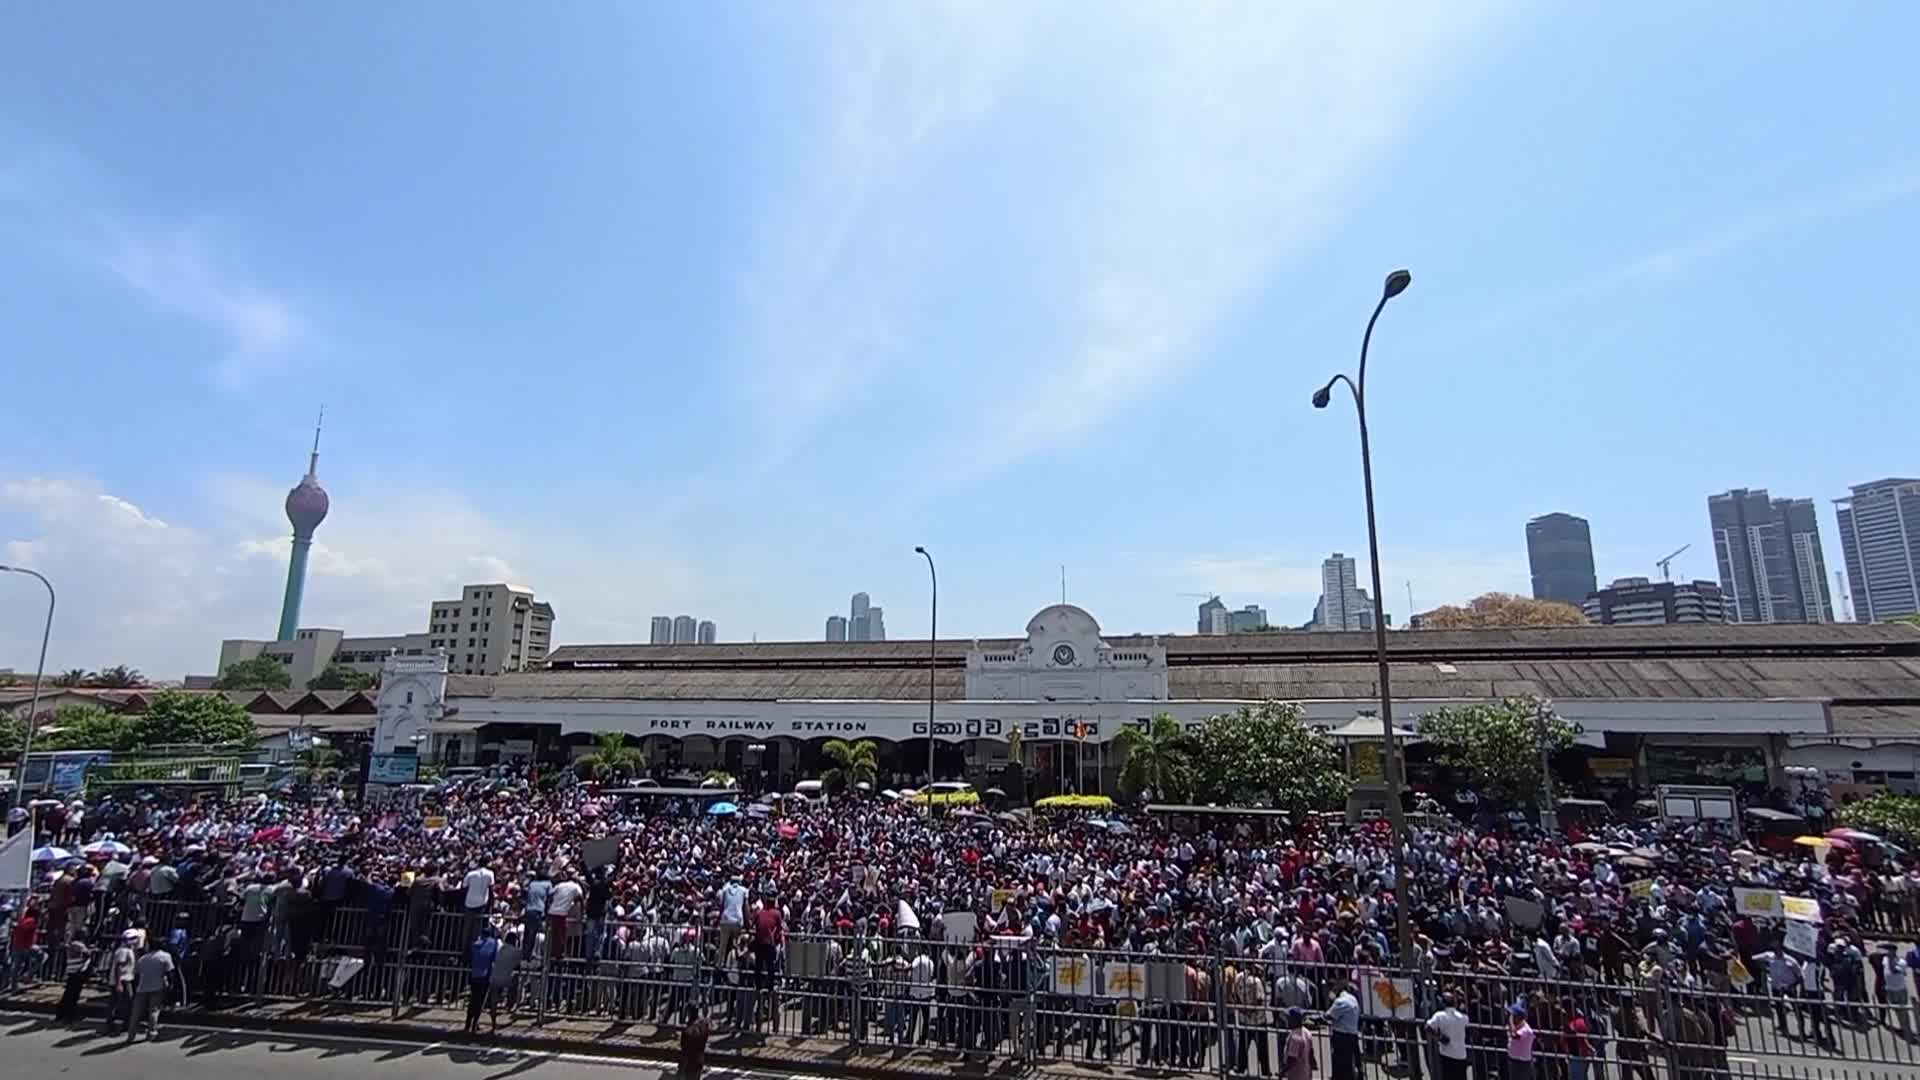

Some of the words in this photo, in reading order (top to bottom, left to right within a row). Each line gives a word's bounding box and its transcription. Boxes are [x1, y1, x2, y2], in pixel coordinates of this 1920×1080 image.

[650, 720, 692, 729] FORT
[706, 720, 775, 730] RAILWAY
[791, 721, 867, 731] STATION
